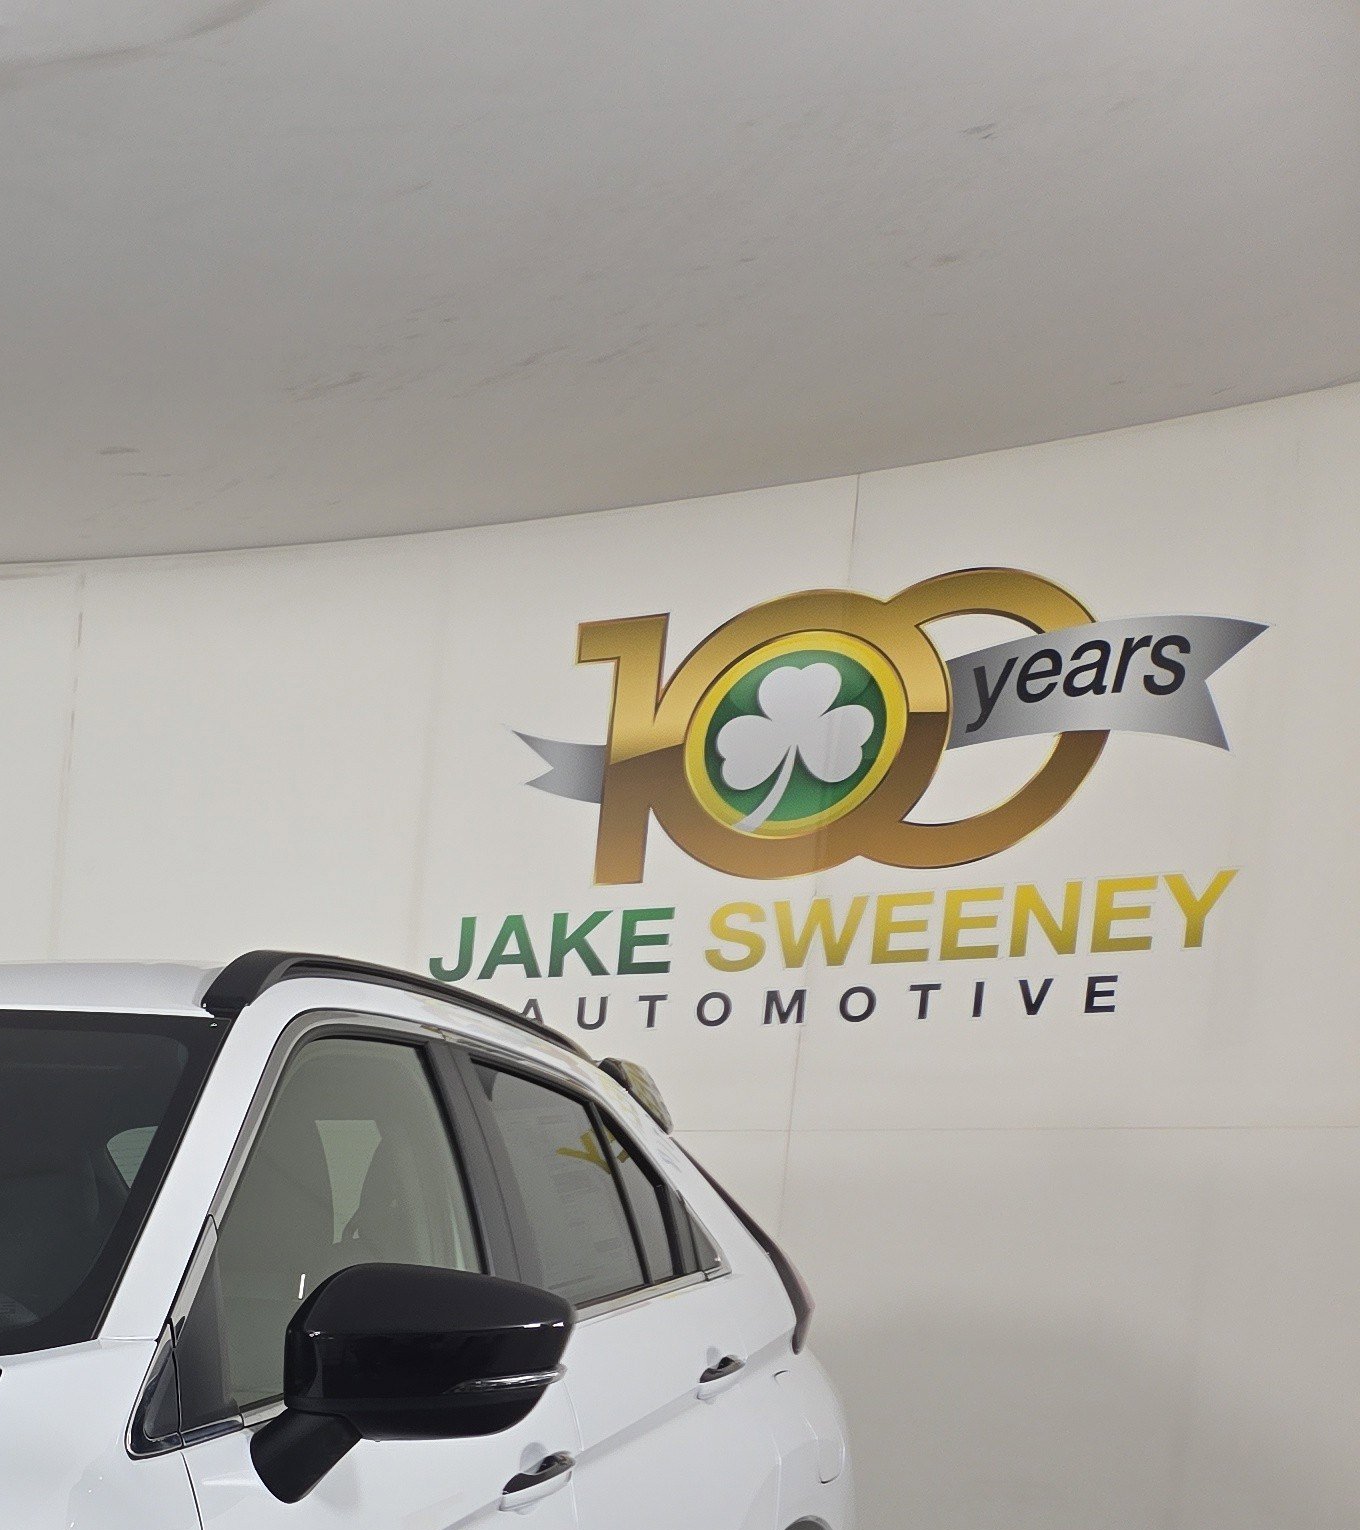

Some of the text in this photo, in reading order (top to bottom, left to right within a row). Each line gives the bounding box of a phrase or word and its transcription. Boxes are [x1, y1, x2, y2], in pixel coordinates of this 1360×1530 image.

[965, 631, 1192, 734] years
[428, 868, 1239, 983] JAKE SWEENEY
[521, 974, 1120, 1031] AUTOMOTIVE
